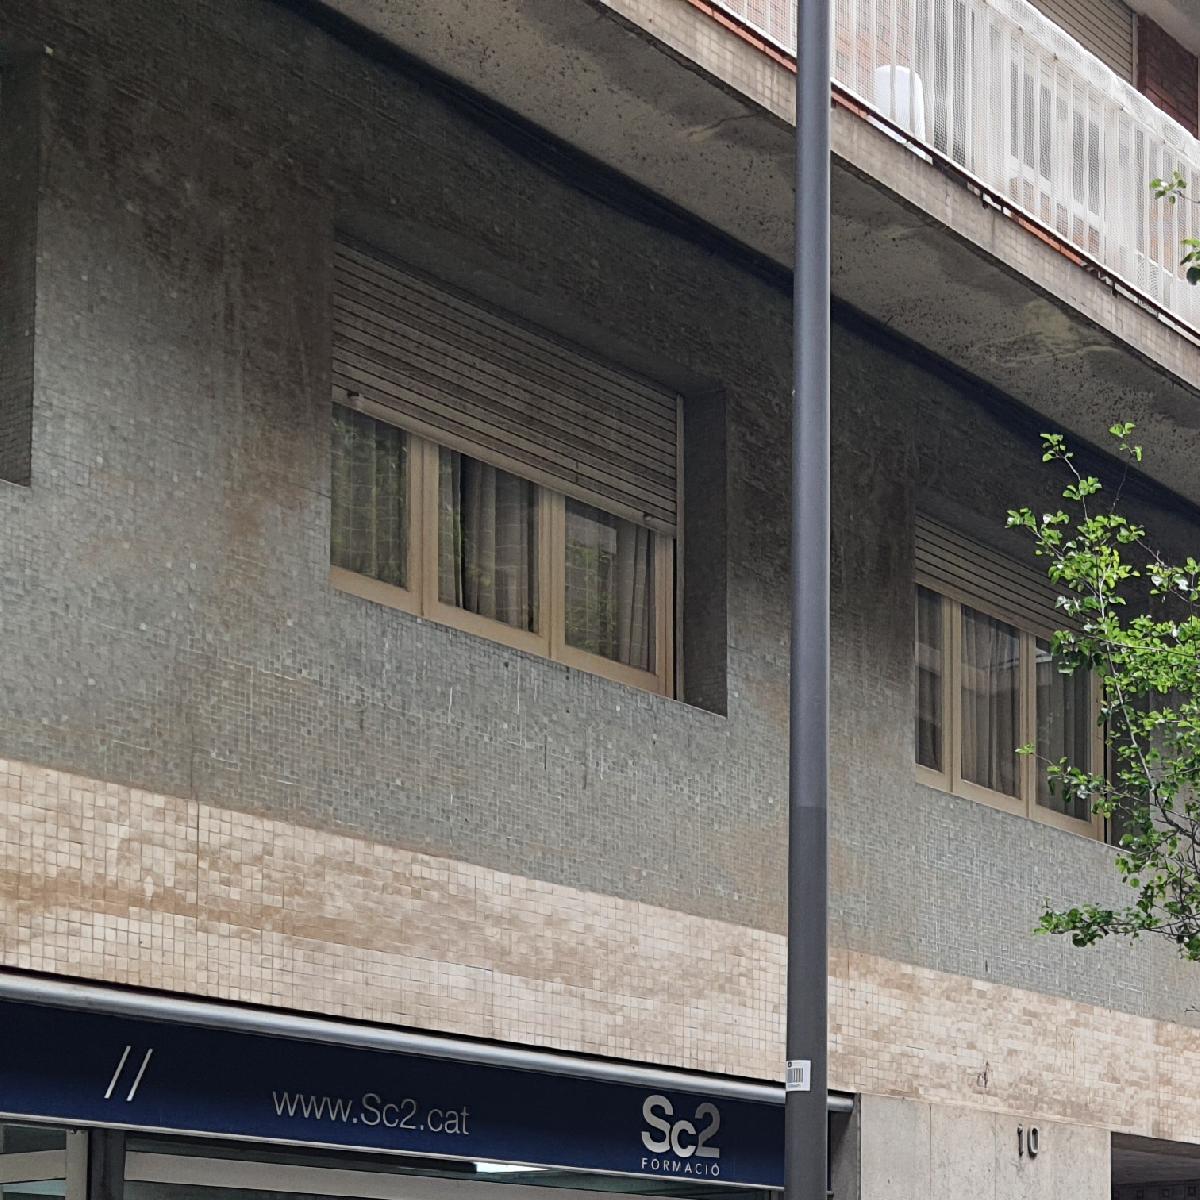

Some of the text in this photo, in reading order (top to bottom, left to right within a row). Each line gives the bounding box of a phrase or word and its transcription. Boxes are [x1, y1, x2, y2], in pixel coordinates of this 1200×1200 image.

[272, 1091, 470, 1135] www.Sc2.cat
[641, 1094, 720, 1158] Sc2
[1017, 1123, 1040, 1160] 10
[641, 1158, 720, 1176] FORMACIÓ
